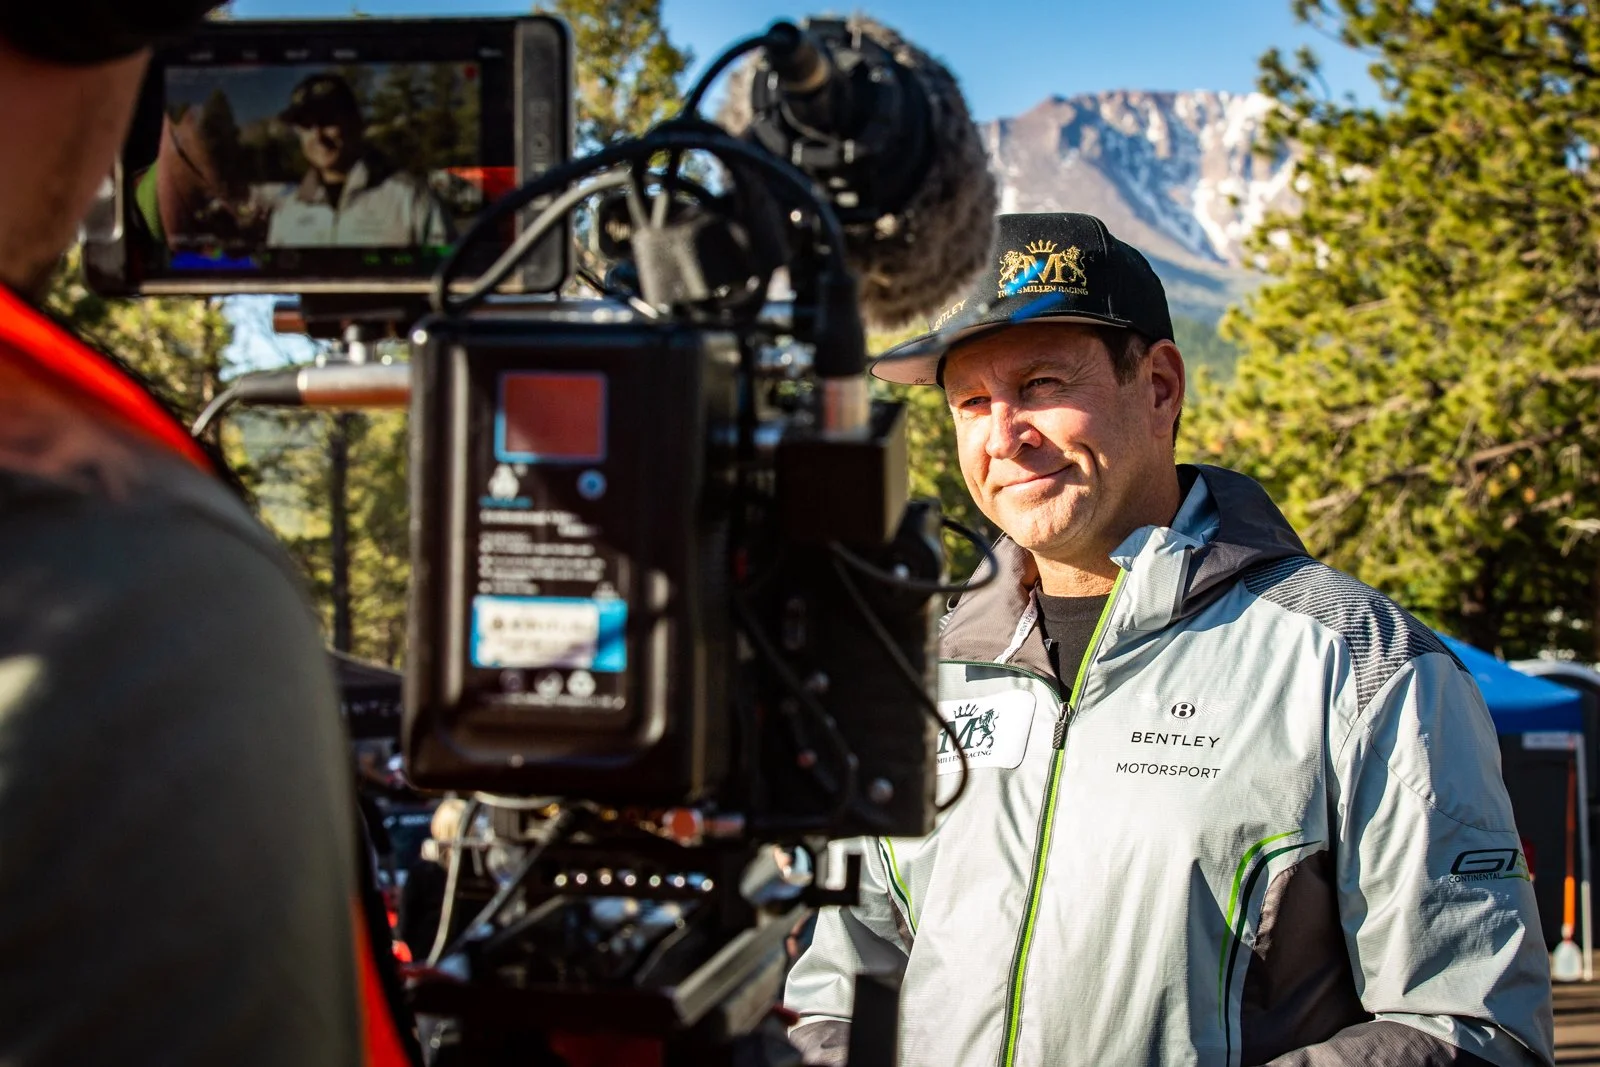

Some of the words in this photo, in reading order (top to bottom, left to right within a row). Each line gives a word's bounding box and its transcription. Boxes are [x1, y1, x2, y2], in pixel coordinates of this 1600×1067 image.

[1059, 286, 1088, 296] RACING
[1131, 731, 1220, 748] BENTLEY
[1116, 763, 1221, 779] MOTORSPORT
[1448, 873, 1501, 884] CONTINENTAL
